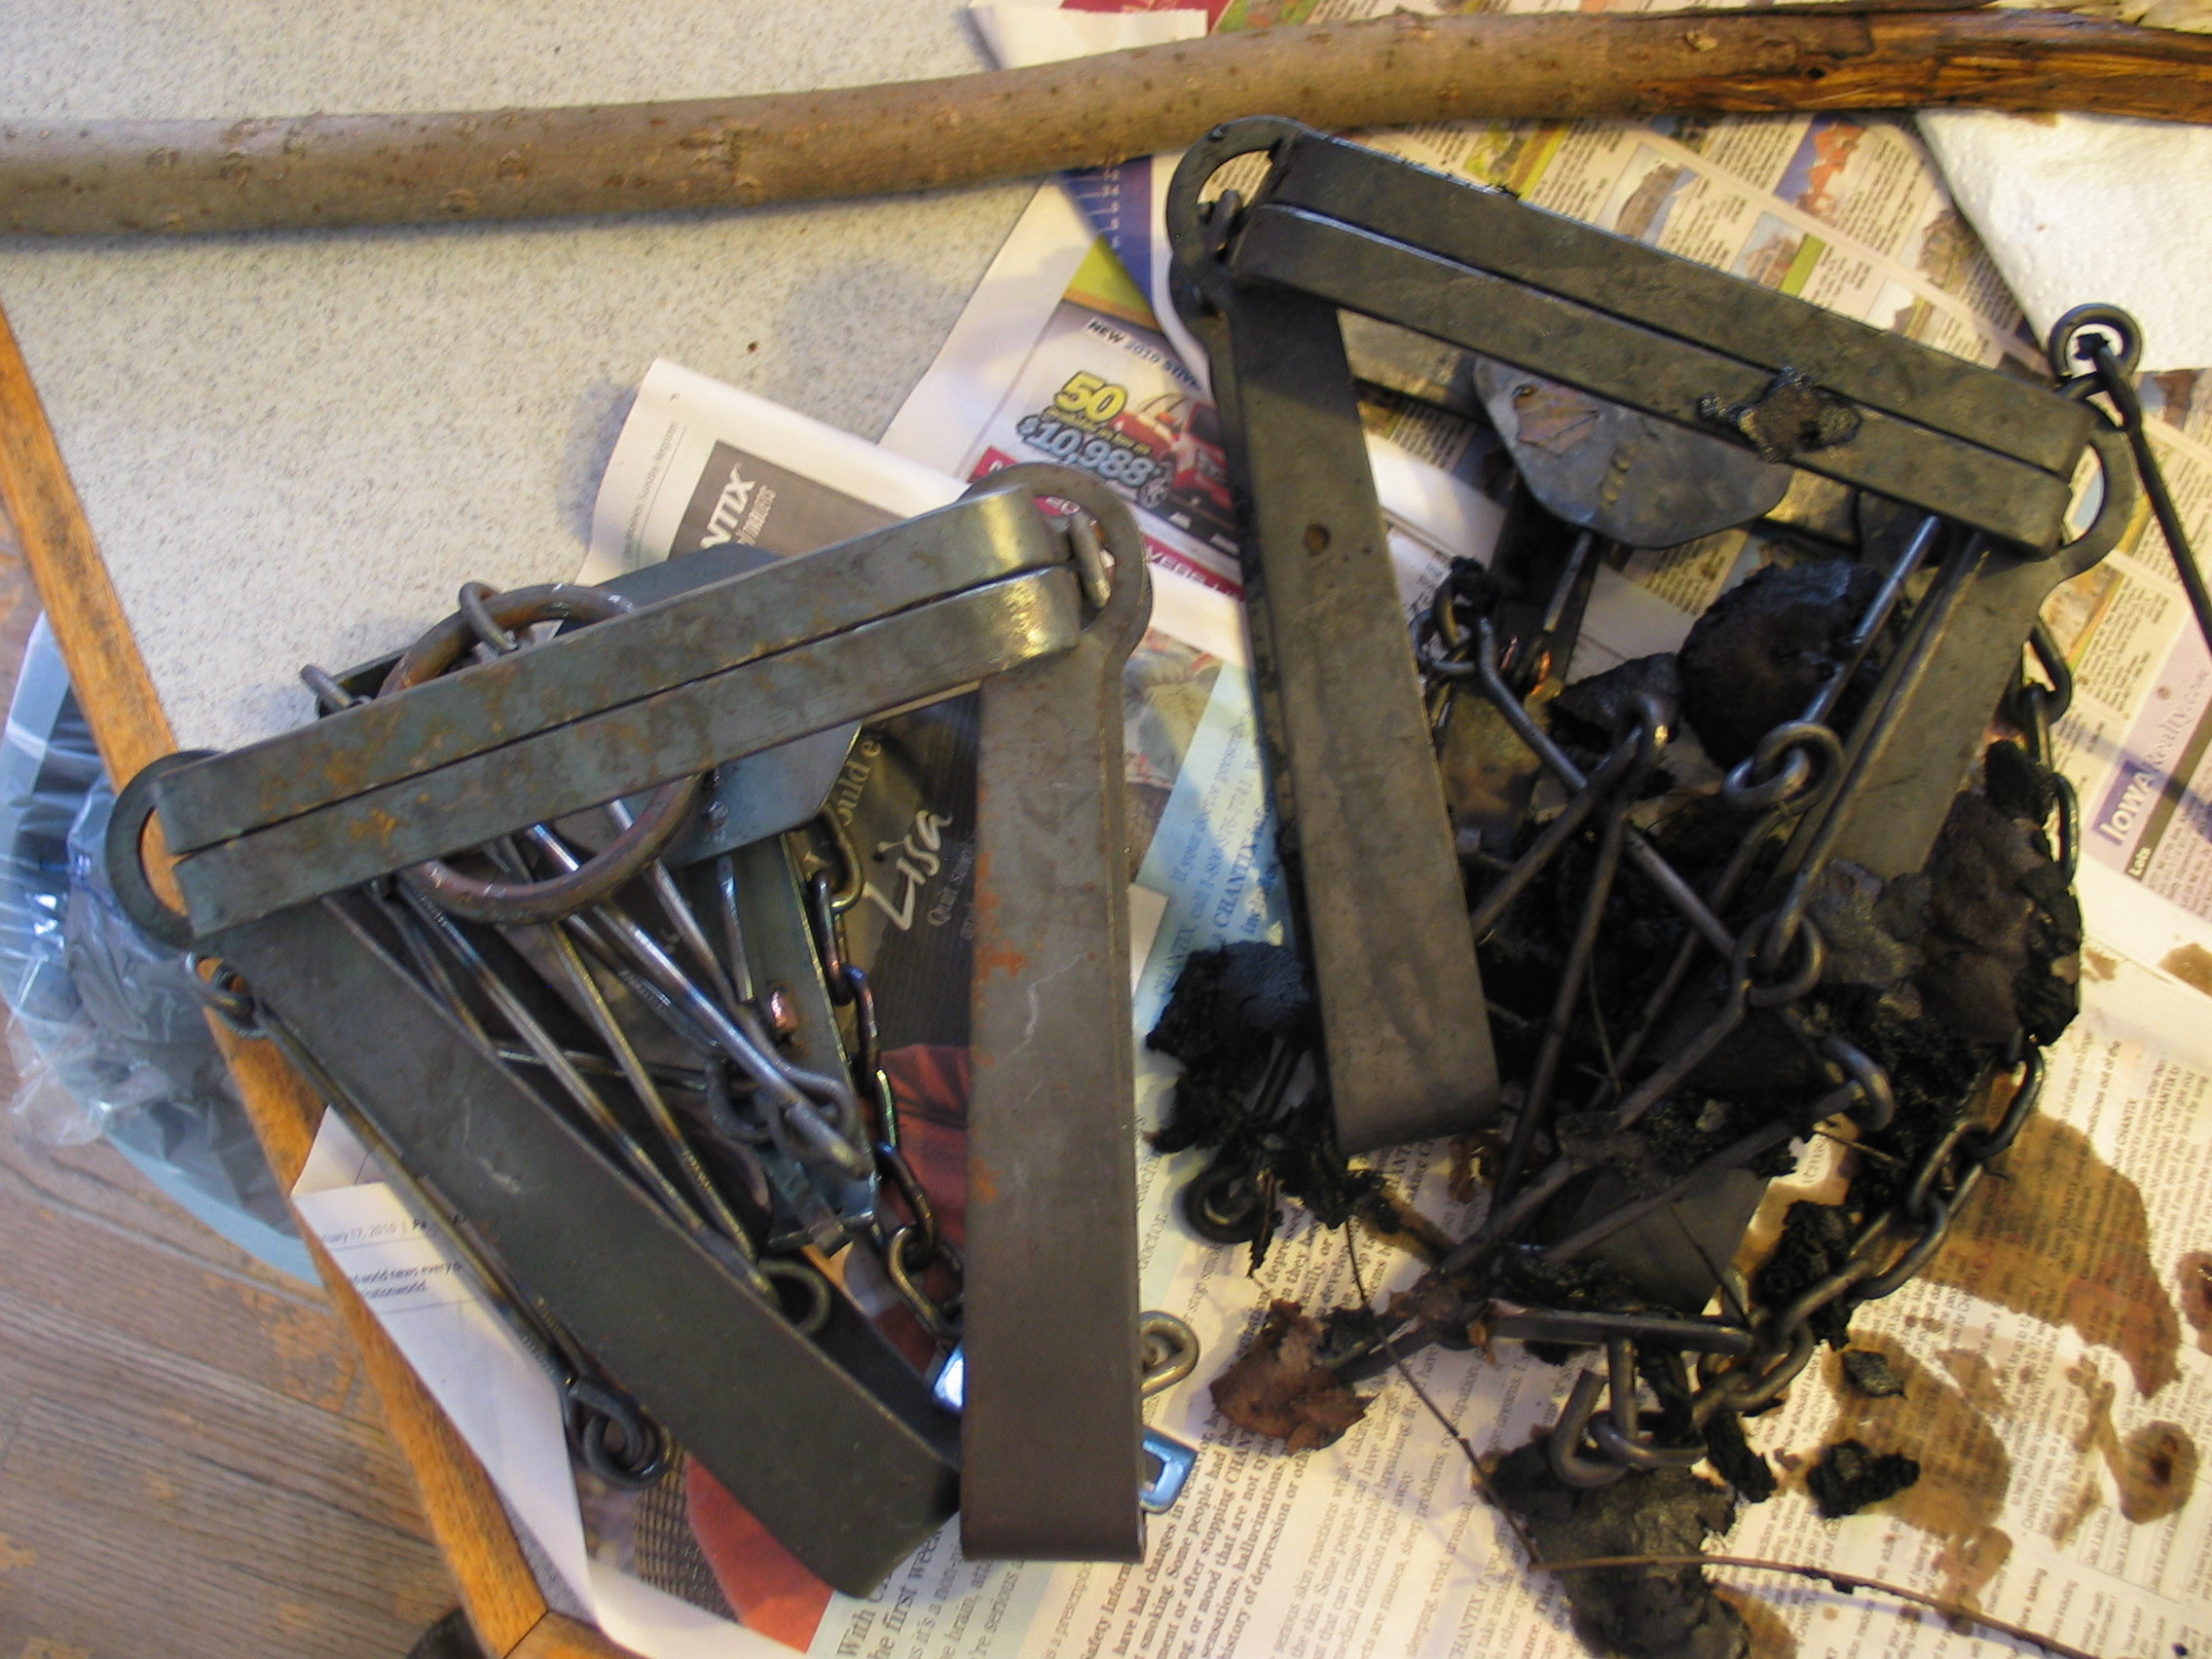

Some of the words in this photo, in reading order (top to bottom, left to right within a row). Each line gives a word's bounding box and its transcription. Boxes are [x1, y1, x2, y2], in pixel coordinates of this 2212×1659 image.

[1086, 317, 1125, 346] NEW
[1056, 366, 1127, 425] 50
[698, 464, 758, 548] NTIX
[863, 805, 953, 933] Lisa
[2126, 843, 2154, 878] Lots
[1207, 837, 1263, 930] CHANTIX
[2103, 1056, 2116, 1070] of
[2151, 1074, 2177, 1124] CHANTIX
[1283, 1248, 1309, 1285] they
[1294, 1256, 1327, 1310] amily,
[1317, 1238, 1333, 1257] or
[1319, 1242, 1354, 1306] develop
[1358, 1441, 1382, 1477] have
[1240, 1474, 1260, 1502] not
[1282, 1480, 1300, 1499] or
[1350, 1478, 1369, 1504] can
[1410, 1449, 1451, 1519] problems,
[1196, 1487, 1237, 1557] stopping
[1230, 1503, 1250, 1531] are
[1271, 1599, 1302, 1653] serious
[1292, 1567, 1314, 1600] skin
[1304, 1499, 1341, 1566] reactions
[1330, 1462, 1353, 1498] while
[1344, 1412, 1374, 1458] taking
[1317, 1612, 1340, 1642] that
[1332, 1587, 1348, 1610] can
[1342, 1540, 1367, 1584] cause
[1355, 1490, 1385, 1542] trouble
[1374, 1420, 1413, 1491] breathing.
[1330, 1504, 1362, 1555] people
[1350, 1542, 1387, 1609] attention
[1376, 1507, 1402, 1543] right
[1390, 1468, 1417, 1508] away.
[1397, 1516, 1424, 1556] sleep
[1135, 1581, 1177, 1652] smoking.
[1164, 1533, 1194, 1579] Some
[1183, 1480, 1218, 1535] people
[1204, 1449, 1228, 1480] had
[1197, 1571, 1244, 1659] sensations,
[1233, 1458, 1289, 1572] hallucinations,
[1212, 1532, 1237, 1567] that
[1247, 1498, 1295, 1587] depression
[1481, 1548, 1505, 1579] you
[1112, 1617, 1138, 1656] have
[1128, 1585, 1151, 1616] had
[1142, 1521, 1179, 1584] changes
[1179, 1557, 1205, 1598] after
[1195, 1568, 1223, 1613] mood
[1239, 1584, 1259, 1605] of
[1312, 1554, 1340, 1597] Some
[1378, 1555, 1410, 1611] nausea,
[1404, 1595, 1440, 1658] sleeping,
[1427, 1555, 1454, 1596] vivid,
[1442, 1498, 1476, 1556] unusual,
[1473, 1578, 1491, 1593] if
[880, 1582, 918, 1634] first
[928, 1602, 942, 1615] a
[943, 1590, 981, 1643] brain,
[979, 1567, 1021, 1634] serious
[1172, 1599, 1189, 1619] or
[1300, 1597, 1324, 1633] skin.
[1368, 1610, 1386, 1636] are
[835, 1604, 876, 1659] With
[1188, 1615, 1203, 1635] or
[1218, 1606, 1251, 1659] history
[1290, 1633, 1309, 1658] the
[1475, 1613, 1499, 1649] take
[1496, 1609, 1522, 1650] other
